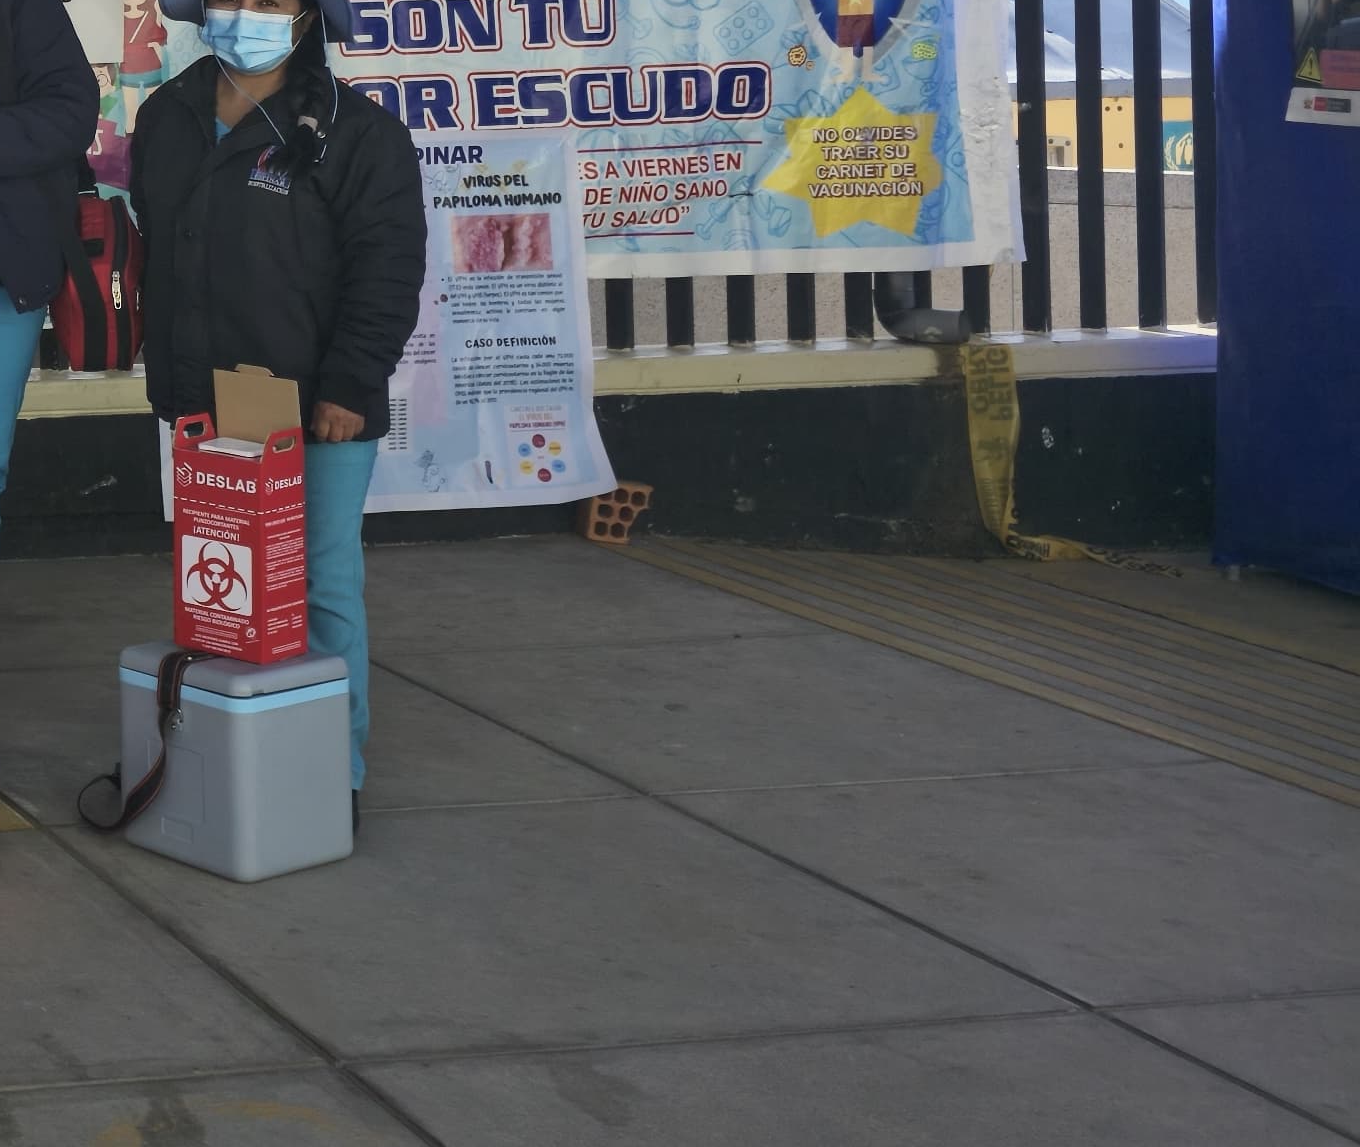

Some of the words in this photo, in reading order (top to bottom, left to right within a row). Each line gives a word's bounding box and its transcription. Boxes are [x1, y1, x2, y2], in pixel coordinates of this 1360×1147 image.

[472, 61, 772, 131] ESCUDO
[812, 128, 837, 143] NO
[842, 126, 918, 142] OLVIDES
[416, 146, 483, 165] PINAR
[821, 146, 878, 161] TRAER
[883, 145, 908, 160] SU
[605, 160, 620, 179] A
[621, 156, 710, 178] VIERNES
[714, 153, 742, 172] EN
[816, 163, 885, 179] CARNET
[891, 163, 915, 177] DE
[463, 175, 501, 189] VIRUS
[504, 174, 528, 187] DEL
[808, 178, 923, 197] VACUNACIÓN
[584, 187, 612, 206] DE
[619, 181, 669, 204] NIÑO
[674, 179, 728, 200] SANO
[433, 194, 502, 209] PAPILOMA
[504, 193, 562, 206] HUMANO
[582, 213, 605, 229] TU
[465, 338, 492, 349] CASO
[497, 335, 556, 347] DEFINICIÓN
[196, 471, 257, 494] DESLAB
[274, 475, 302, 490] DESLAB
